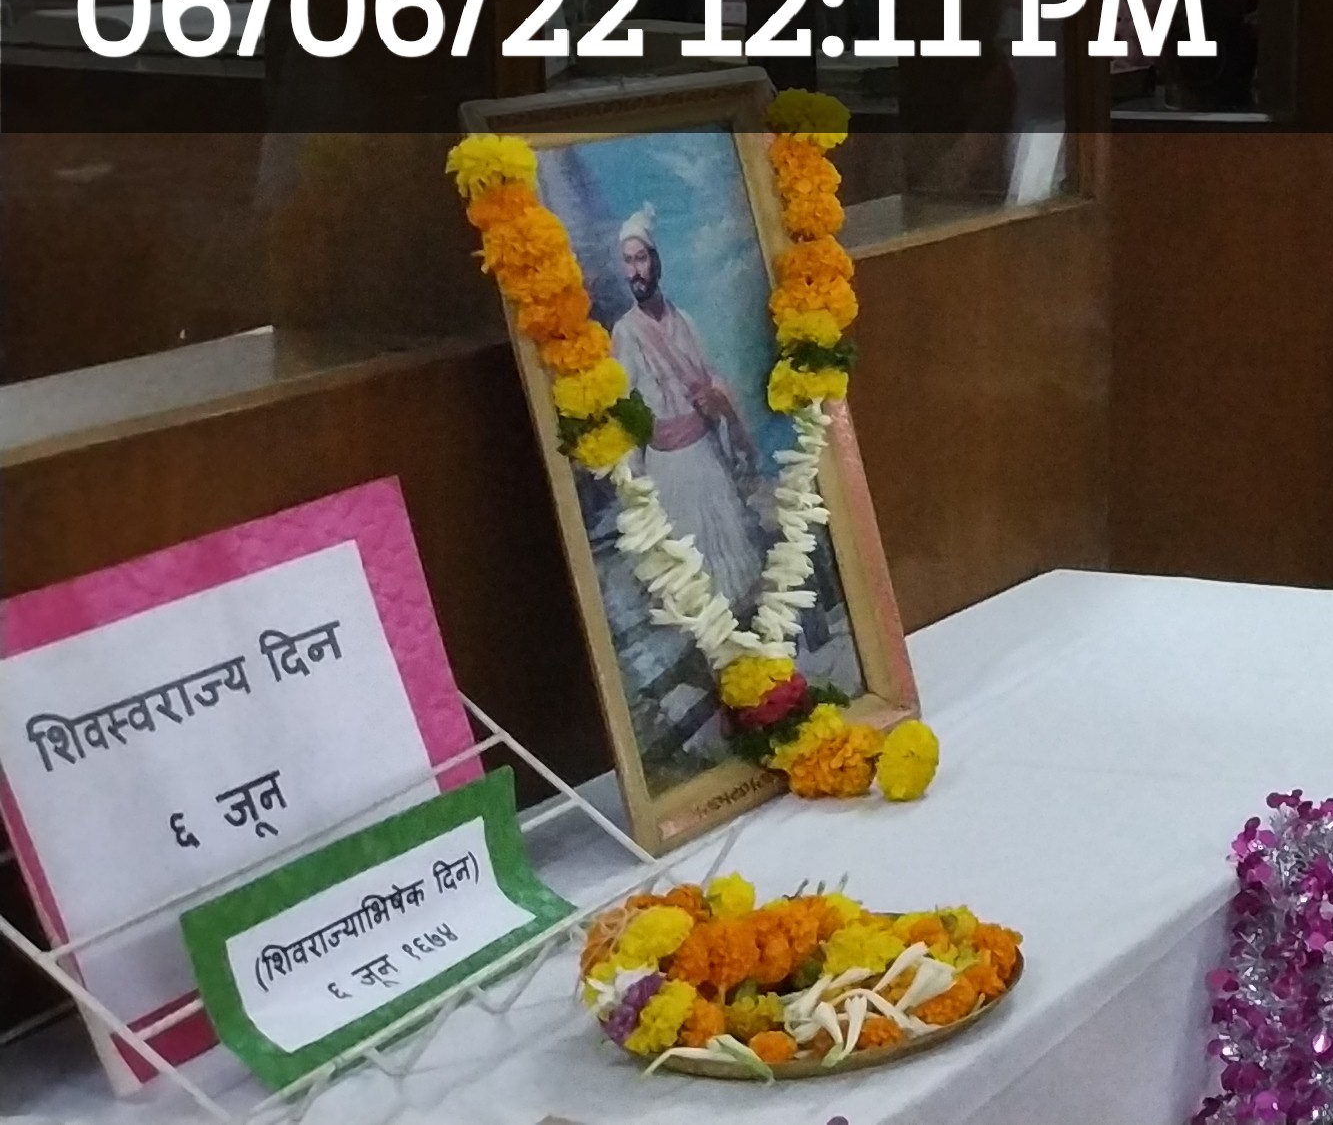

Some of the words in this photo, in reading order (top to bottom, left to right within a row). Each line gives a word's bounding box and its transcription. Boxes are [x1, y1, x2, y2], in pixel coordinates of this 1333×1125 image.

[26, 655, 252, 772] शिवस्वराज्य
[258, 620, 342, 682] दिन
[169, 812, 200, 848] ६
[215, 770, 288, 838] जून
[255, 879, 425, 992] (शिवराज्याभिषेक
[432, 851, 479, 894] दिन)
[327, 982, 352, 999] ६
[351, 954, 399, 988] जून
[401, 923, 459, 961] १६७४
